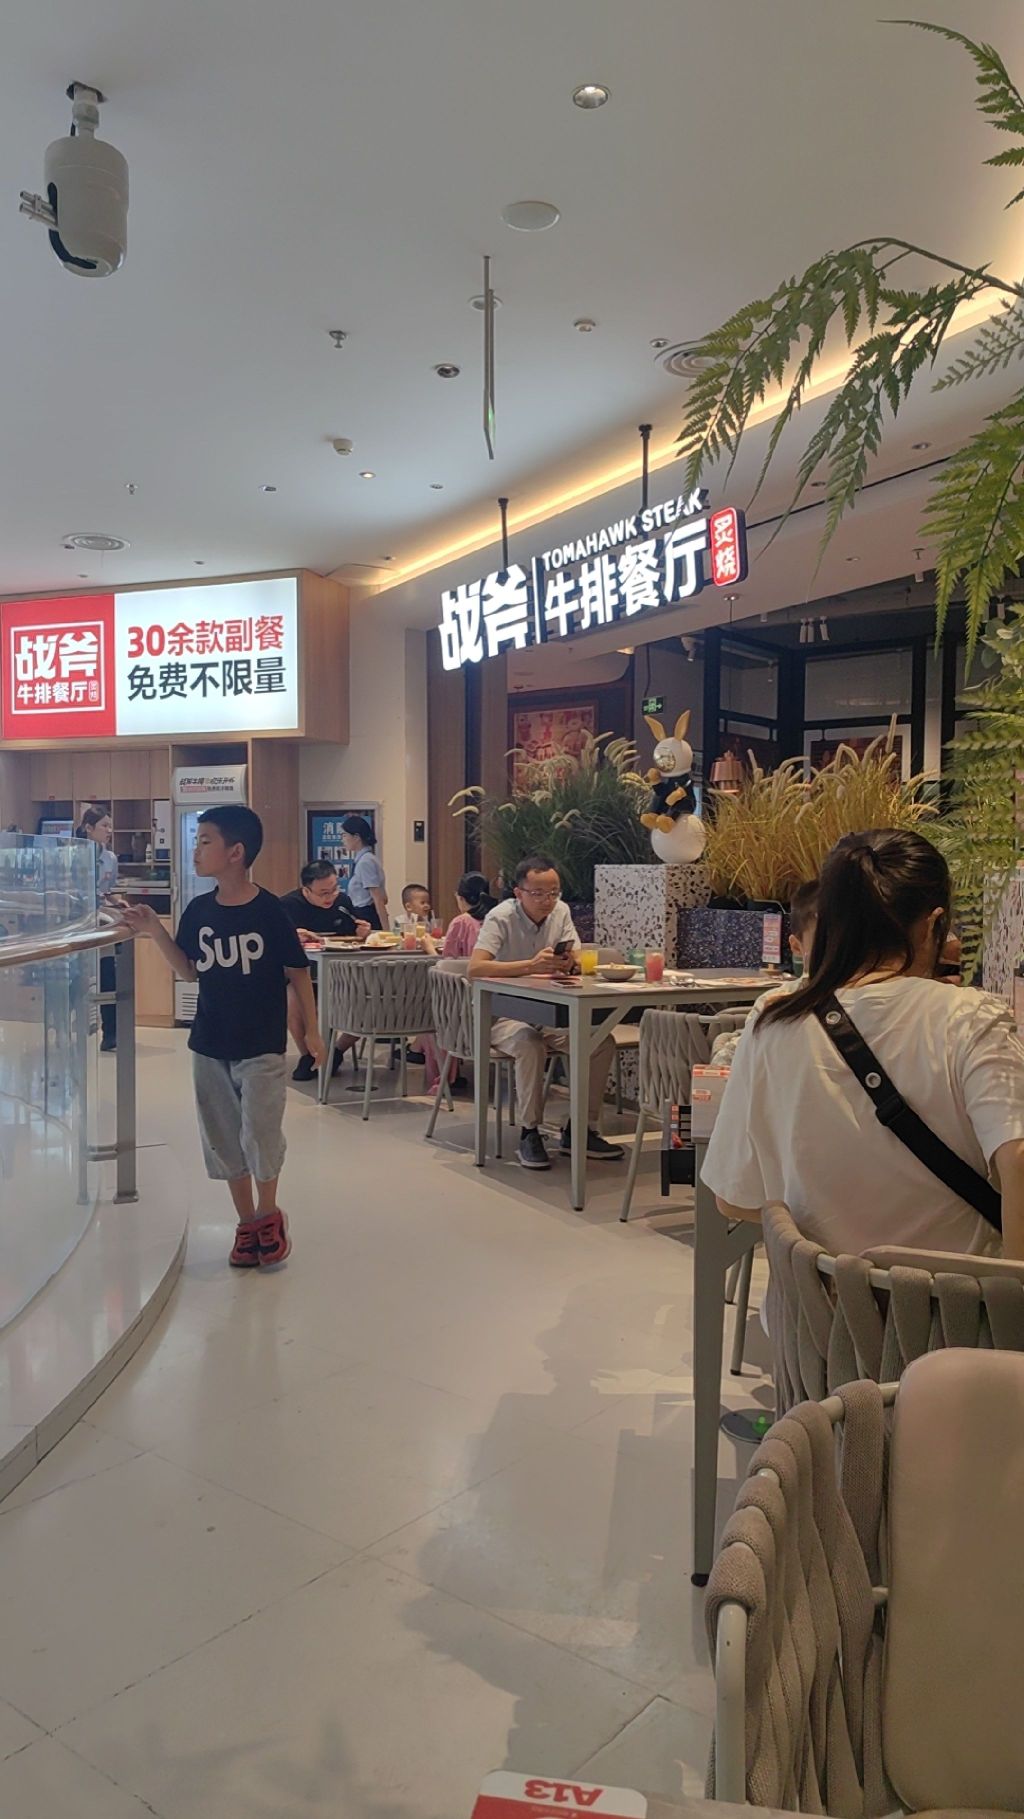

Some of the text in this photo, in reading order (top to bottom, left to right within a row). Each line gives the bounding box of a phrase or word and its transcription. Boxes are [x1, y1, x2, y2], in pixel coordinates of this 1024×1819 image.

[542, 487, 702, 572] TOMAHAWK STEAK
[713, 514, 737, 579] 炙烧
[544, 518, 708, 637] 牛排餐厅
[127, 615, 284, 658] 30余款副餐
[438, 563, 529, 672] 战斧
[15, 631, 98, 681] 战斧
[127, 656, 287, 701] 免费不限量
[16, 680, 88, 704] 牛排餐厅
[196, 926, 264, 975] Sup
[524, 1779, 604, 1807] A13
